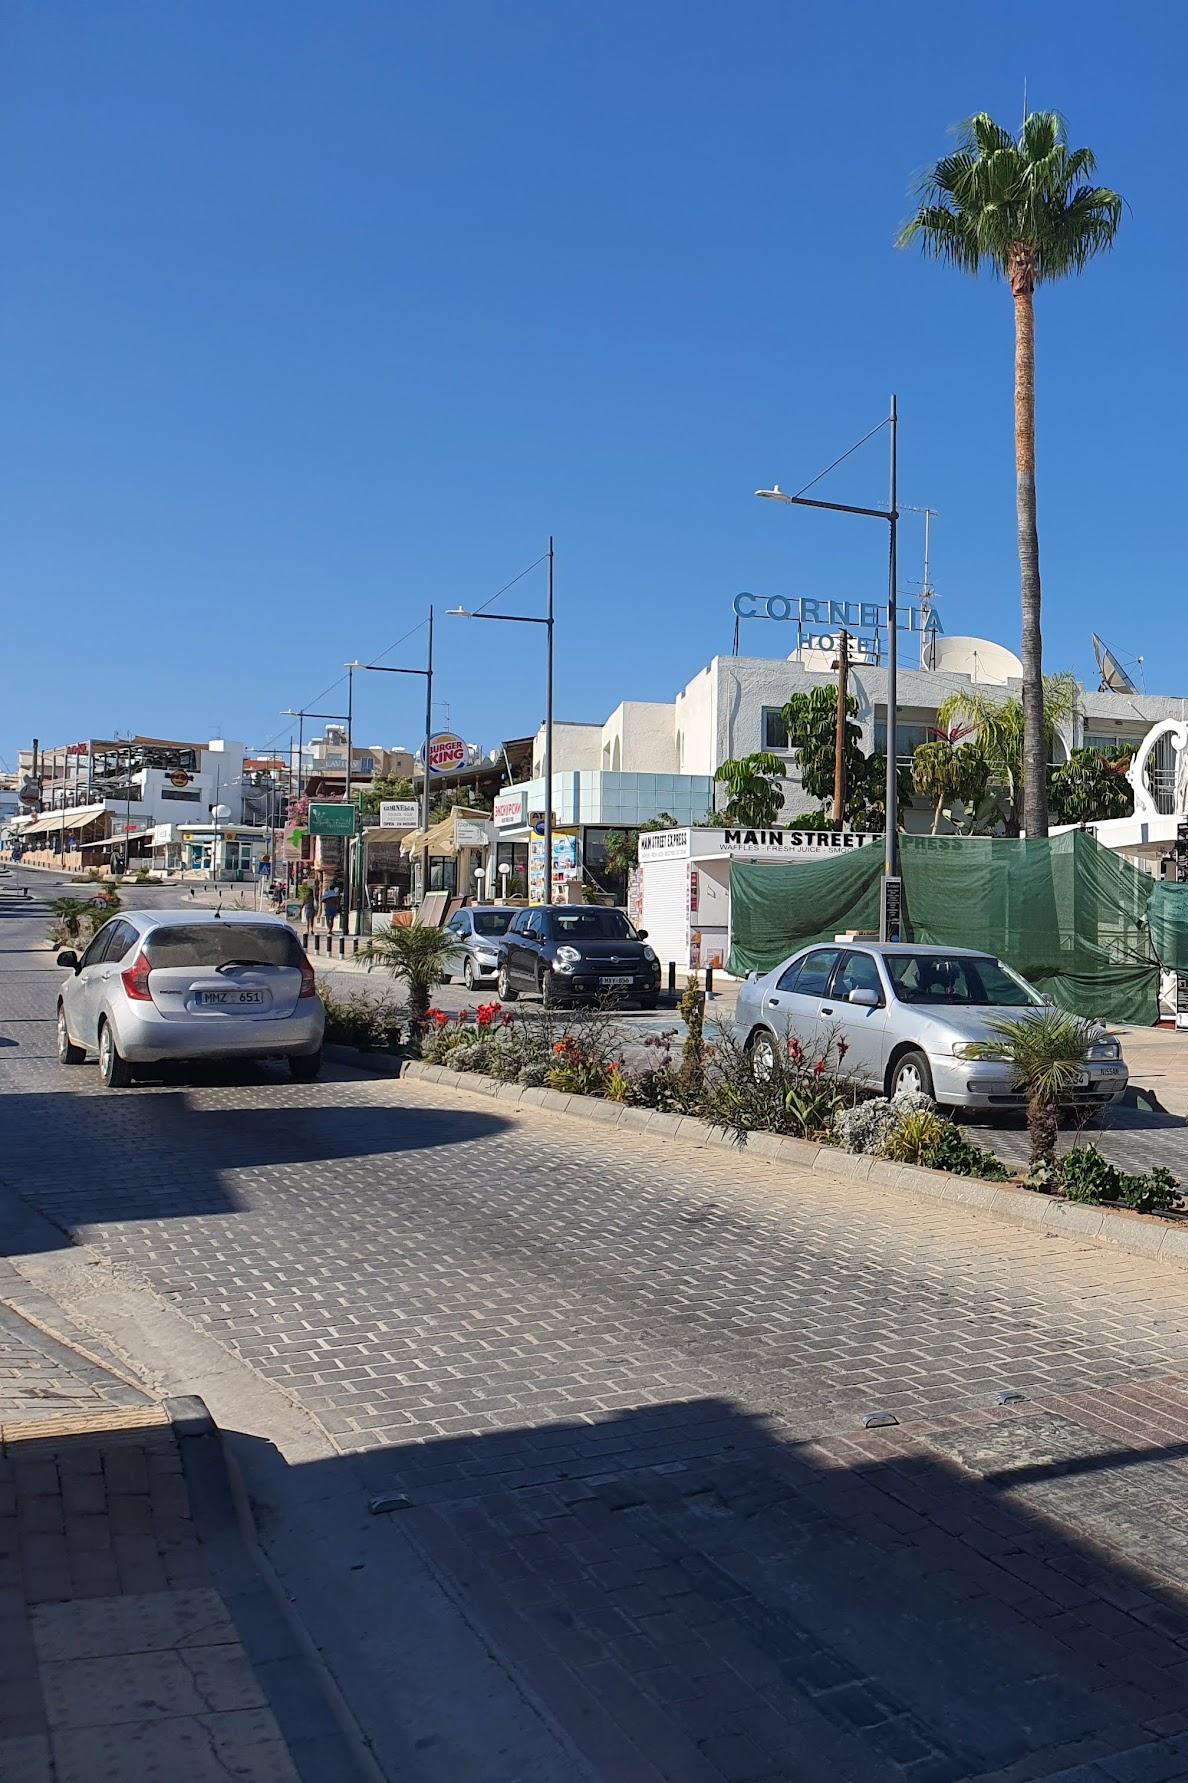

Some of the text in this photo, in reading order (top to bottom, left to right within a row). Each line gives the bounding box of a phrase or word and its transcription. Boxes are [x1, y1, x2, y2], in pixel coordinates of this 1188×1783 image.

[797, 633, 888, 653] HOEL
[429, 749, 464, 765] KING
[641, 832, 687, 850] MAIN STREET EXPRESS
[725, 829, 783, 846] MAIN
[791, 831, 866, 848] STREET
[205, 992, 260, 1003] MMZ 651
